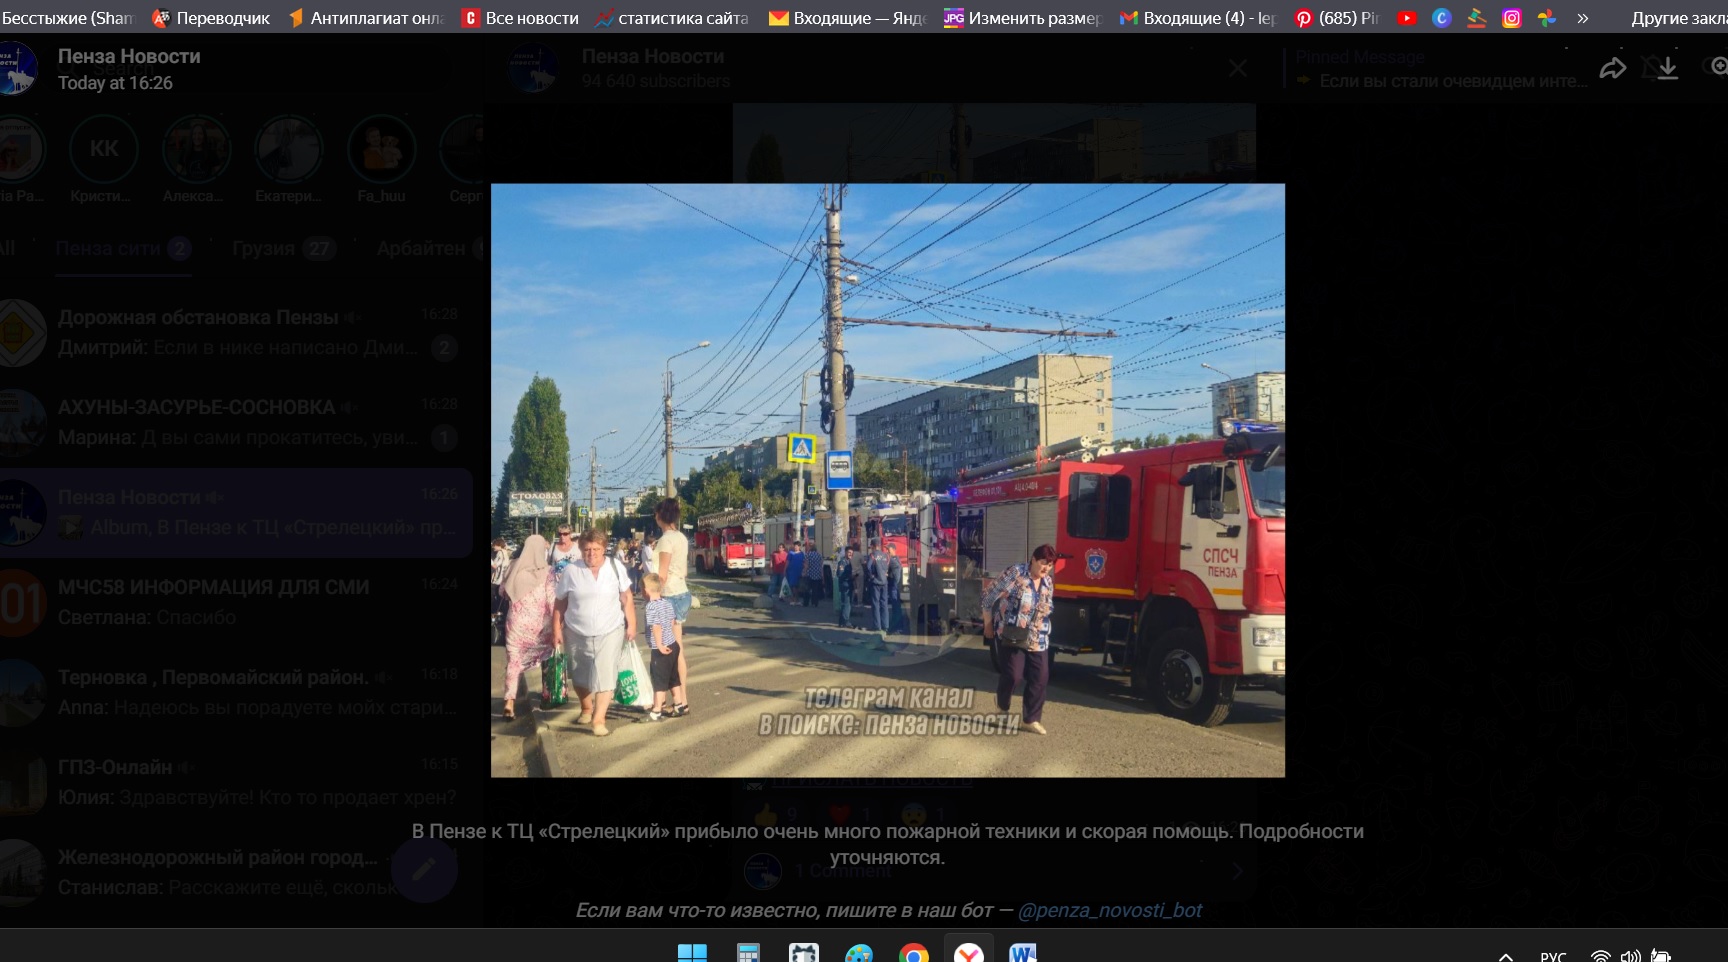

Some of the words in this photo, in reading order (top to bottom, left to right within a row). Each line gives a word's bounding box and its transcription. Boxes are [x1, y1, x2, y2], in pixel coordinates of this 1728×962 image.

[3, 12, 87, 24] Бесстыжие
[178, 12, 270, 27] Переводчик
[311, 12, 409, 24] Антиплагиат
[487, 12, 513, 24] Все
[518, 15, 578, 24] новости
[619, 15, 702, 24] статистика
[707, 12, 746, 24] сайта
[795, 12, 871, 26] Входящие
[944, 12, 964, 23] JPG
[970, 12, 1045, 24] Изменить
[1145, 12, 1221, 26] Входящие
[1226, 11, 1244, 26] (4)
[1320, 11, 1357, 26] (685)
[1632, 12, 1688, 27] Другие
[59, 48, 115, 64] Пенза
[121, 49, 200, 64] Новости
[583, 48, 639, 64] Пенза
[645, 48, 724, 64] Новости
[1296, 49, 1348, 63] Pinned
[1354, 50, 1424, 68] Message
[58, 75, 105, 93] Today
[110, 77, 125, 89] at
[130, 76, 173, 89] 16:26
[582, 74, 601, 87] 94
[606, 74, 635, 87] 640
[640, 73, 730, 88] subscribers
[1321, 74, 1359, 87] Если
[1366, 77, 1390, 88] вы
[1396, 77, 1437, 88] стали
[1443, 77, 1535, 90] очевидцем
[71, 190, 130, 204] Кристи...
[163, 190, 223, 201] Алекса...
[256, 190, 321, 204] Екатери...
[358, 189, 405, 203] Fa_huu
[56, 240, 112, 256] Пенза
[119, 244, 160, 256] сити
[175, 242, 185, 255] 2
[234, 241, 295, 259] Грузия
[310, 242, 329, 255] 27
[377, 240, 465, 259] Арбайтен
[58, 309, 156, 328] Дорожная
[162, 308, 271, 325] обстановка
[277, 309, 338, 325] Пензы
[422, 308, 457, 319] 16:28
[58, 339, 147, 358] Дмитрий:
[155, 340, 197, 354] Если
[204, 343, 214, 354] в
[220, 343, 263, 355] нике
[270, 343, 358, 354] написано
[440, 341, 449, 354] 2
[58, 399, 336, 415] АХУНЫ-ЗАСУРЬЕ-СОСНОВКА
[422, 398, 457, 409] 16:28
[59, 429, 136, 448] Марина:
[141, 429, 156, 448] Д
[162, 433, 187, 444] вы
[194, 433, 240, 444] сами
[247, 433, 367, 448] прокатитесь,
[440, 431, 447, 444] 1
[59, 488, 115, 504] Пенза
[122, 488, 200, 507] Новости
[421, 488, 458, 499] 16:26
[91, 519, 152, 537] Album,
[158, 519, 169, 534] В
[174, 520, 231, 535] Пензе
[252, 520, 279, 538] ТЦ
[285, 519, 414, 538] «Стрелецкий»
[1203, 548, 1238, 563] СПСЧ
[1208, 566, 1238, 578] ПЕНЗА
[59, 579, 124, 595] МЧС58
[131, 579, 272, 598] ИНФОРМАЦИЯ
[278, 579, 319, 598] ДЛЯ
[325, 579, 369, 594] СМИ
[422, 578, 458, 589] 16:24
[1, 583, 40, 624] 01
[59, 609, 151, 624] Светлана:
[157, 609, 236, 624] Спасибо
[58, 669, 147, 688] Терновка
[163, 669, 302, 688] Первомайский
[308, 669, 368, 688] район.
[422, 668, 457, 680] 16:18
[58, 699, 108, 714] Anna:
[115, 700, 199, 717] Надеюсь
[205, 703, 230, 714] вы
[237, 703, 332, 718] порадуете
[59, 759, 172, 775] ГПЗ-Онлайн
[422, 758, 458, 769] 16:15
[59, 789, 114, 804] Юлия:
[120, 789, 253, 808] Здравствуйте!
[260, 789, 291, 804] Кто
[297, 793, 317, 805] то
[323, 793, 399, 808] продает
[404, 789, 456, 808] хрен?
[413, 824, 424, 838] В
[430, 824, 486, 839] Пензе
[492, 827, 502, 838] к
[507, 823, 533, 842] ТЦ
[539, 823, 669, 842] «Стрелецкий»
[675, 823, 758, 842] прибыло
[764, 827, 818, 838] очень
[825, 827, 880, 838] много
[887, 823, 980, 842] пожарной
[985, 827, 1059, 839] техники
[1066, 827, 1076, 838] и
[1082, 827, 1146, 842] скорая
[1153, 827, 1233, 841] помощь.
[1240, 823, 1363, 842] Подробности
[58, 849, 243, 868] Железнодорожный
[249, 849, 304, 868] район
[830, 853, 945, 868] уточняются.
[810, 863, 891, 877] Comment
[59, 879, 163, 895] Станислав:
[170, 880, 280, 895] Расскажите
[286, 880, 327, 897] ещё,
[576, 902, 621, 918] Если
[626, 906, 663, 917] вам
[669, 906, 726, 917] что-то
[730, 906, 820, 920] известно,
[826, 906, 897, 918] пишите
[901, 906, 912, 917] в
[918, 906, 957, 917] наш
[962, 901, 994, 918] бот
[1019, 902, 1203, 922] @penza_novosti_bot
